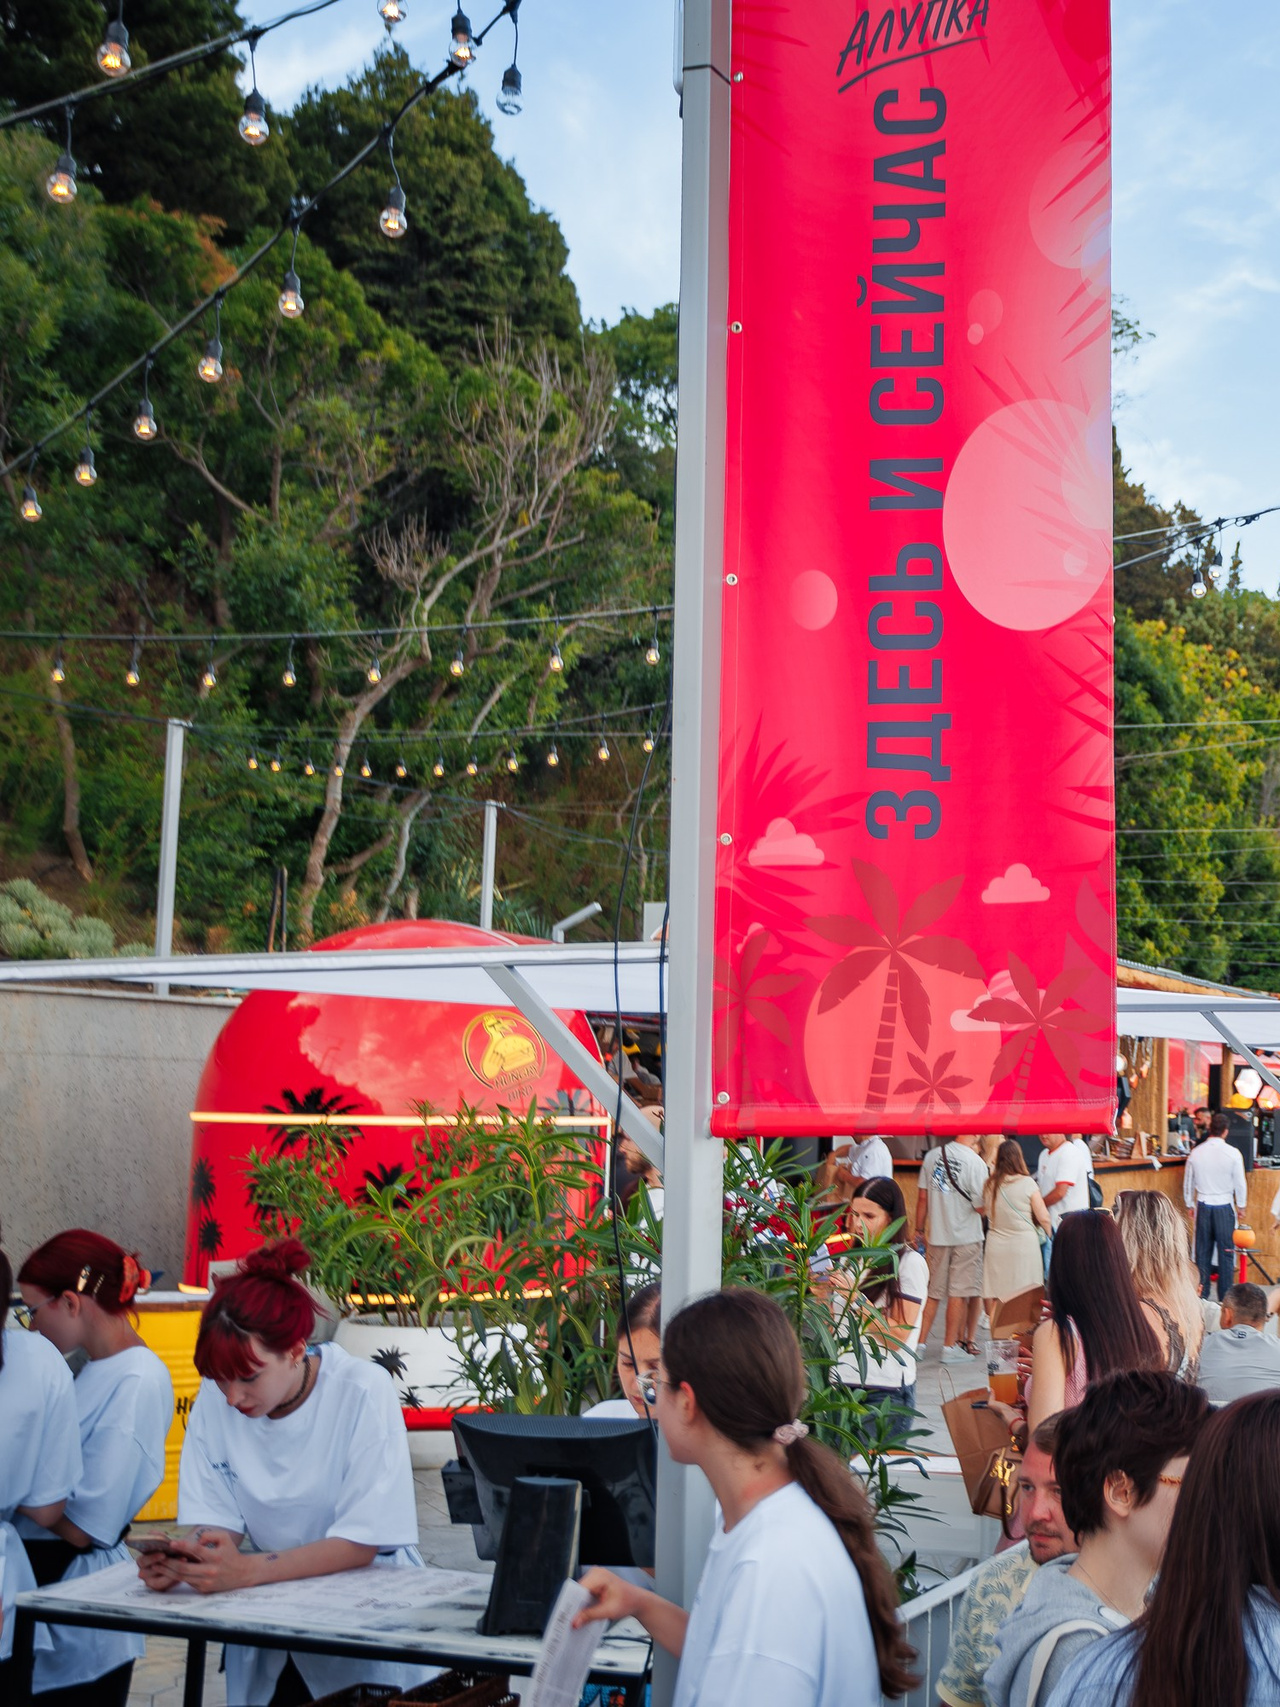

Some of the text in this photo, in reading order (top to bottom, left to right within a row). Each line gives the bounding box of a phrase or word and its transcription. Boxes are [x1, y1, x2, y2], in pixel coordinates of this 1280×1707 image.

[836, 0, 990, 77] АЛУПКА
[857, 87, 951, 840] ЗДЕСЬ И СЕЙЧАС
